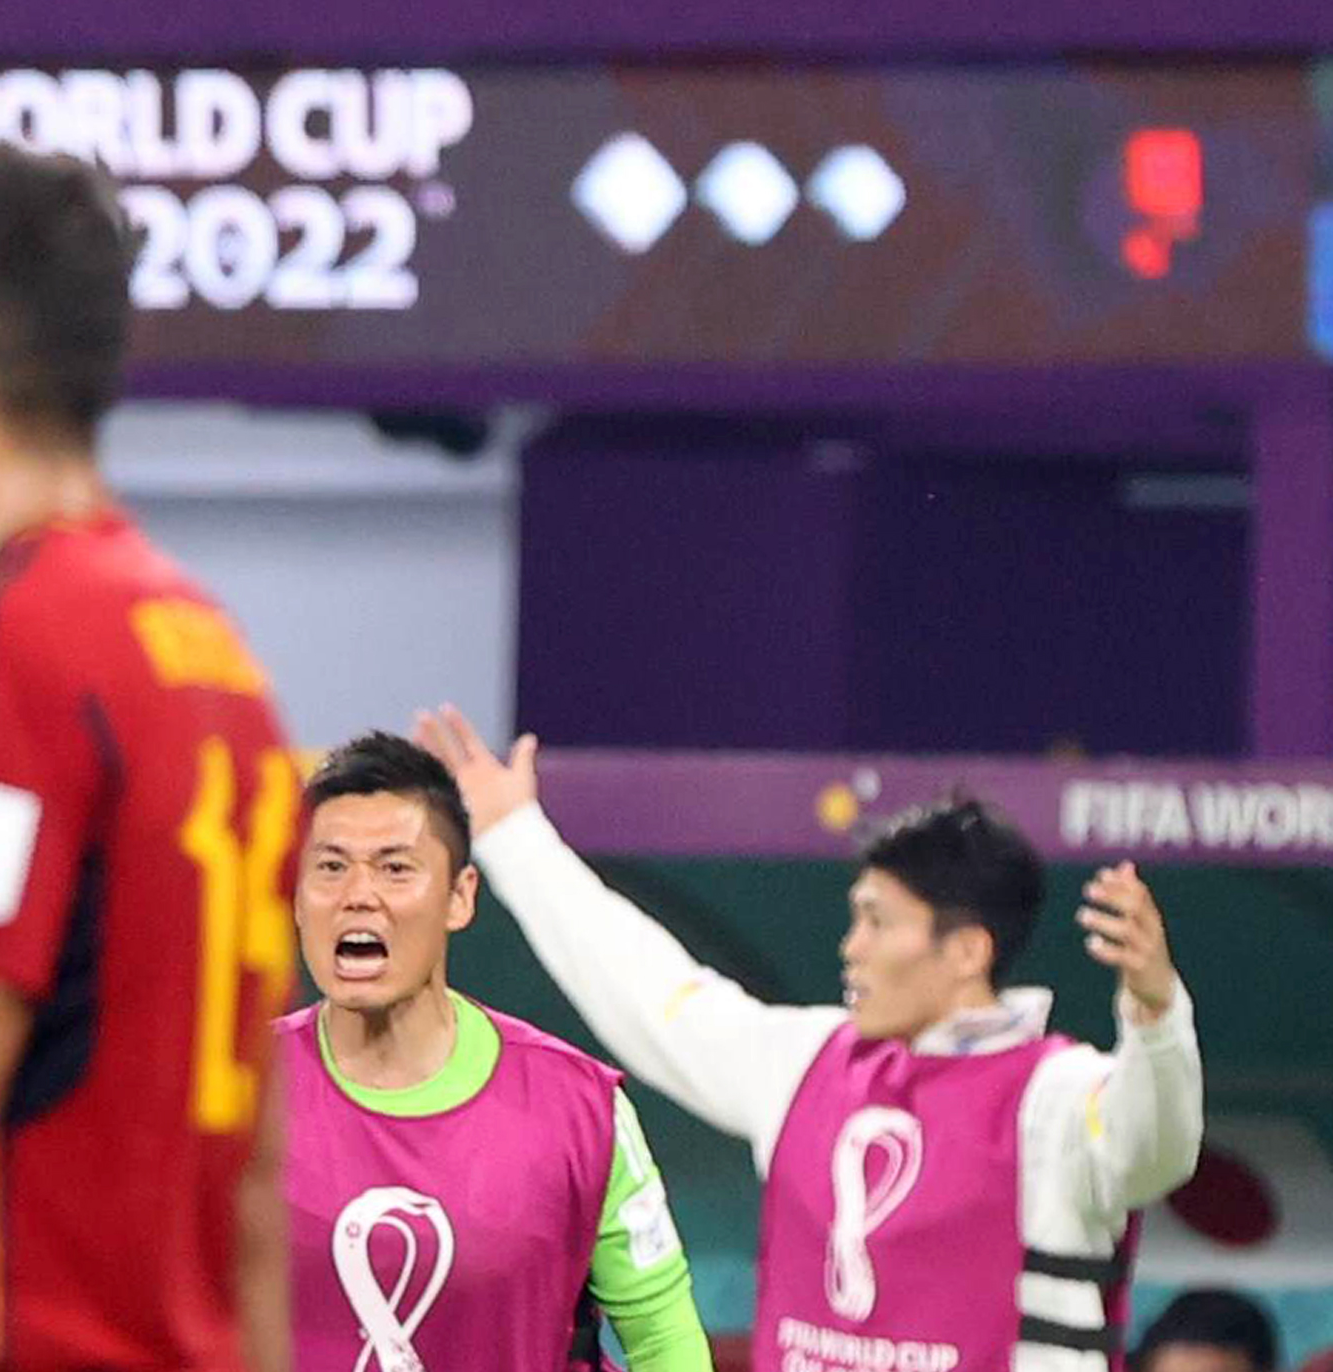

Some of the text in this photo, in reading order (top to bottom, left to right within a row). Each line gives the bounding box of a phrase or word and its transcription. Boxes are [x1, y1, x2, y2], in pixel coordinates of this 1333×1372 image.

[263, 68, 475, 180] CUP
[1060, 780, 1333, 850] FIFA WOR
